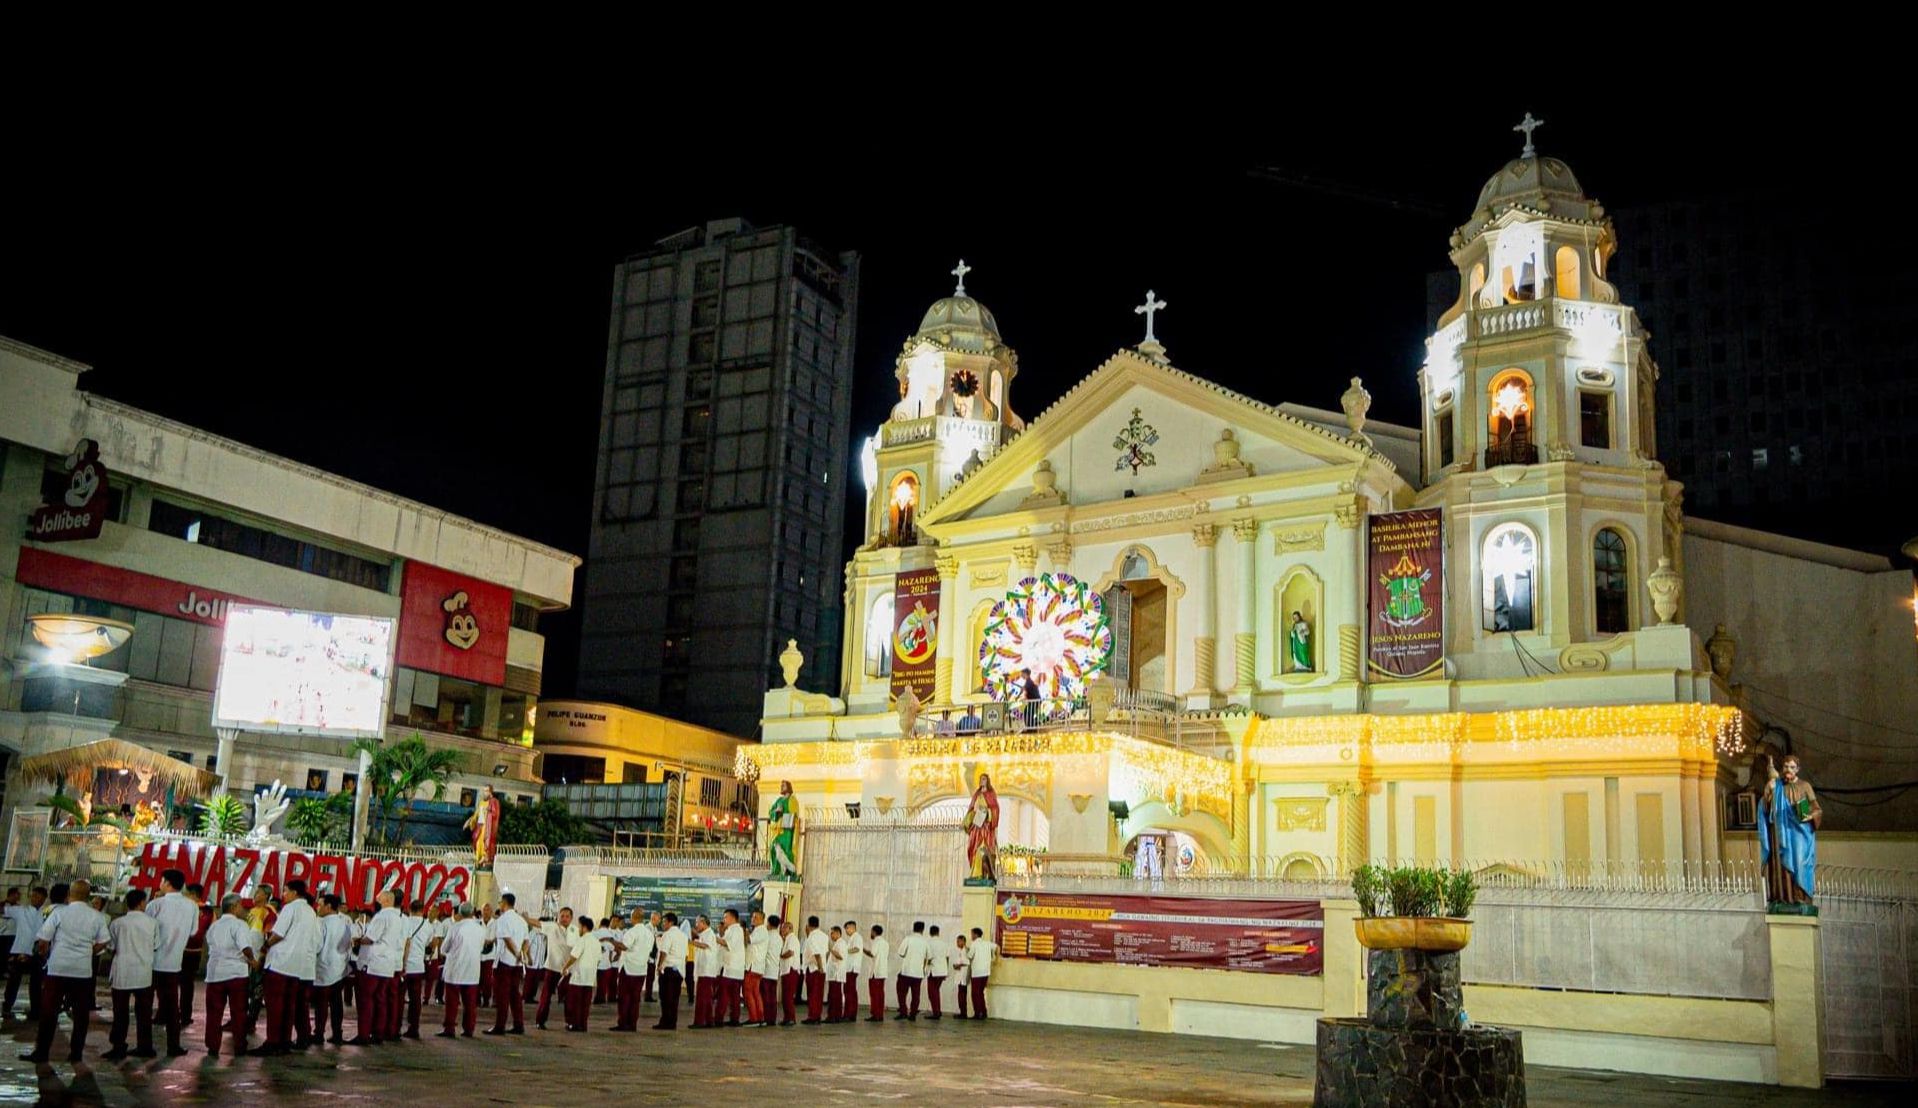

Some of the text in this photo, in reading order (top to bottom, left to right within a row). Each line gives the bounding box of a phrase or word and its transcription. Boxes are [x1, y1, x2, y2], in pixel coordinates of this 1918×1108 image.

[36, 510, 91, 534] Jollibee
[1371, 519, 1439, 533] BASILIKA MENOR
[910, 584, 929, 594] 2024
[179, 591, 227, 621] Joll
[1372, 632, 1441, 645] JESUS NAZARENO
[574, 711, 606, 721] GUANZON
[1023, 907, 1082, 916] NAZARENO
